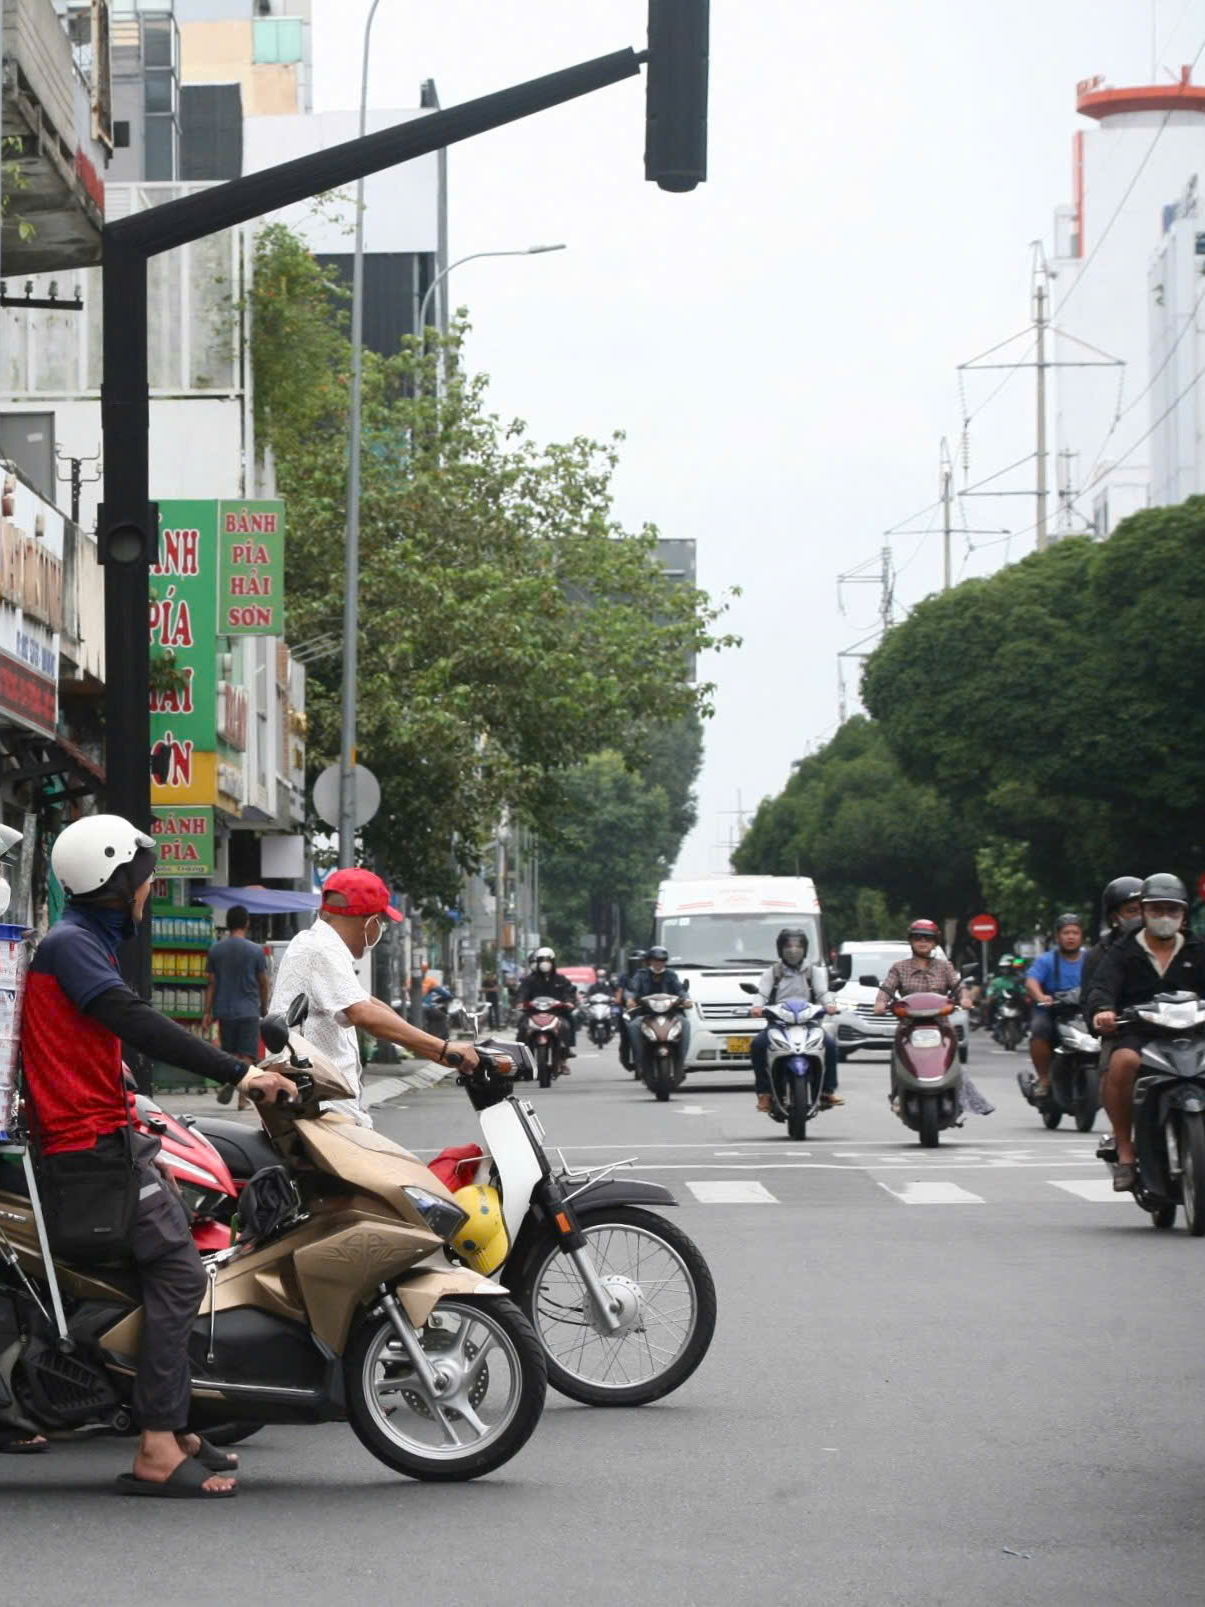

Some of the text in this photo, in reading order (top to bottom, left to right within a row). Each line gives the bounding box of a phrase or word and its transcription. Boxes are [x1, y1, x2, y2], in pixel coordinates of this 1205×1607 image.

[225, 509, 278, 535] BÁNH
[231, 541, 271, 565] PÍA
[230, 569, 272, 597] HẢI
[227, 603, 273, 627] SƠN
[153, 814, 206, 835] BÁNH
[160, 840, 199, 860] PÍA
